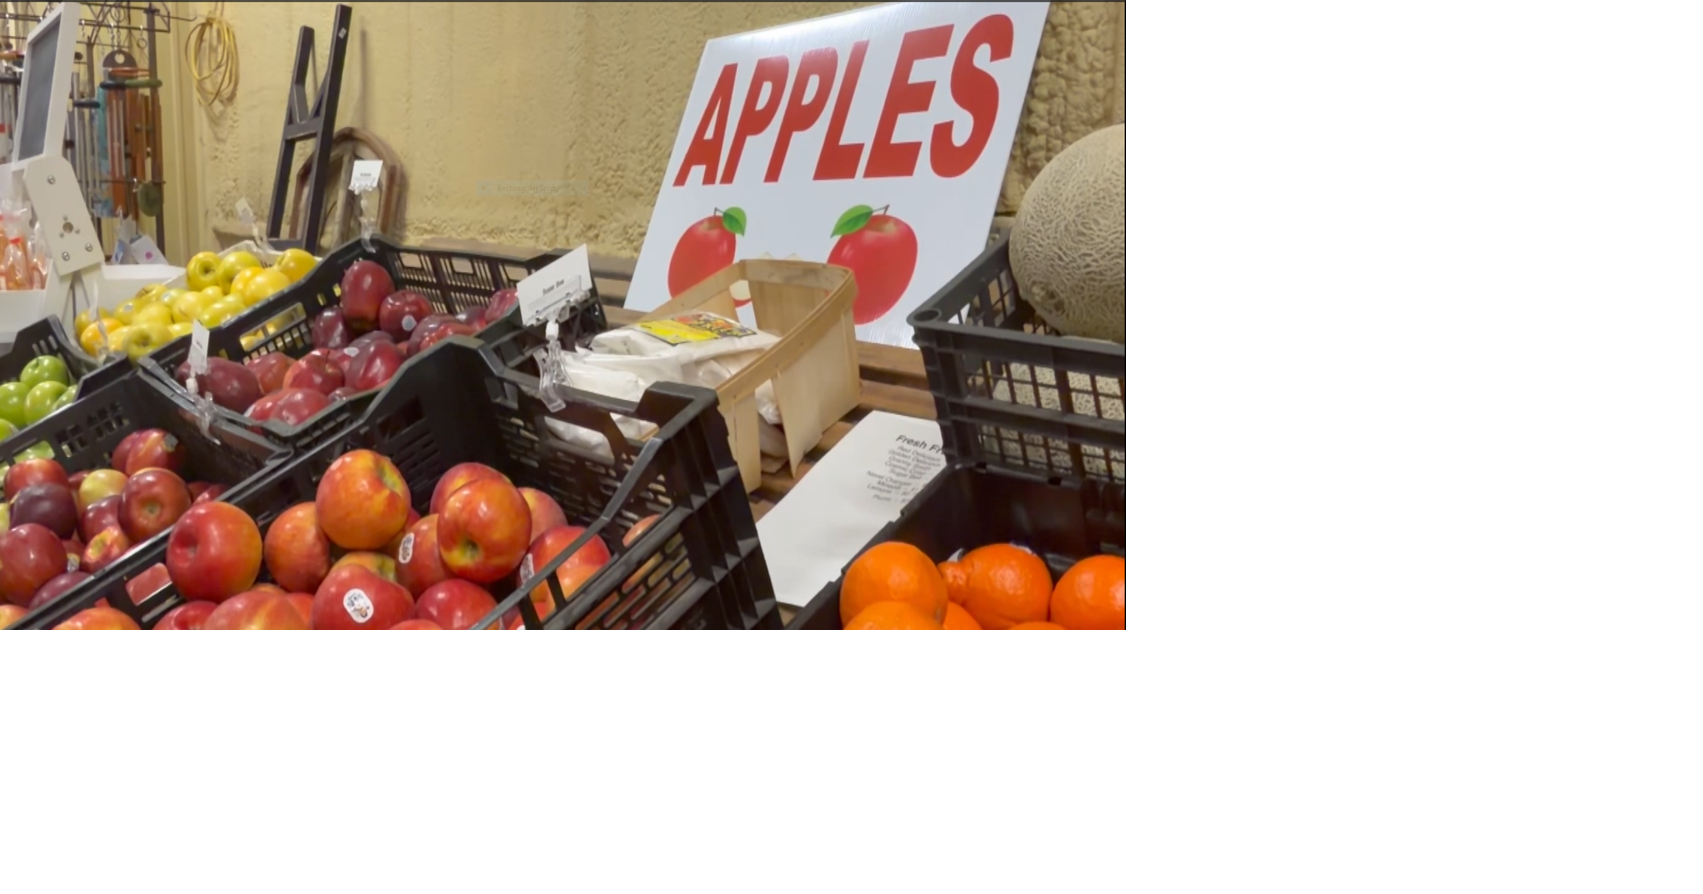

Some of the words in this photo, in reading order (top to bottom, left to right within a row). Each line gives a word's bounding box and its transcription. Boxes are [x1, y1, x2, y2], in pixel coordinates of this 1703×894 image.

[672, 13, 1014, 187] APPLES
[896, 434, 927, 449] Fresh
[928, 444, 942, 454] Fr
